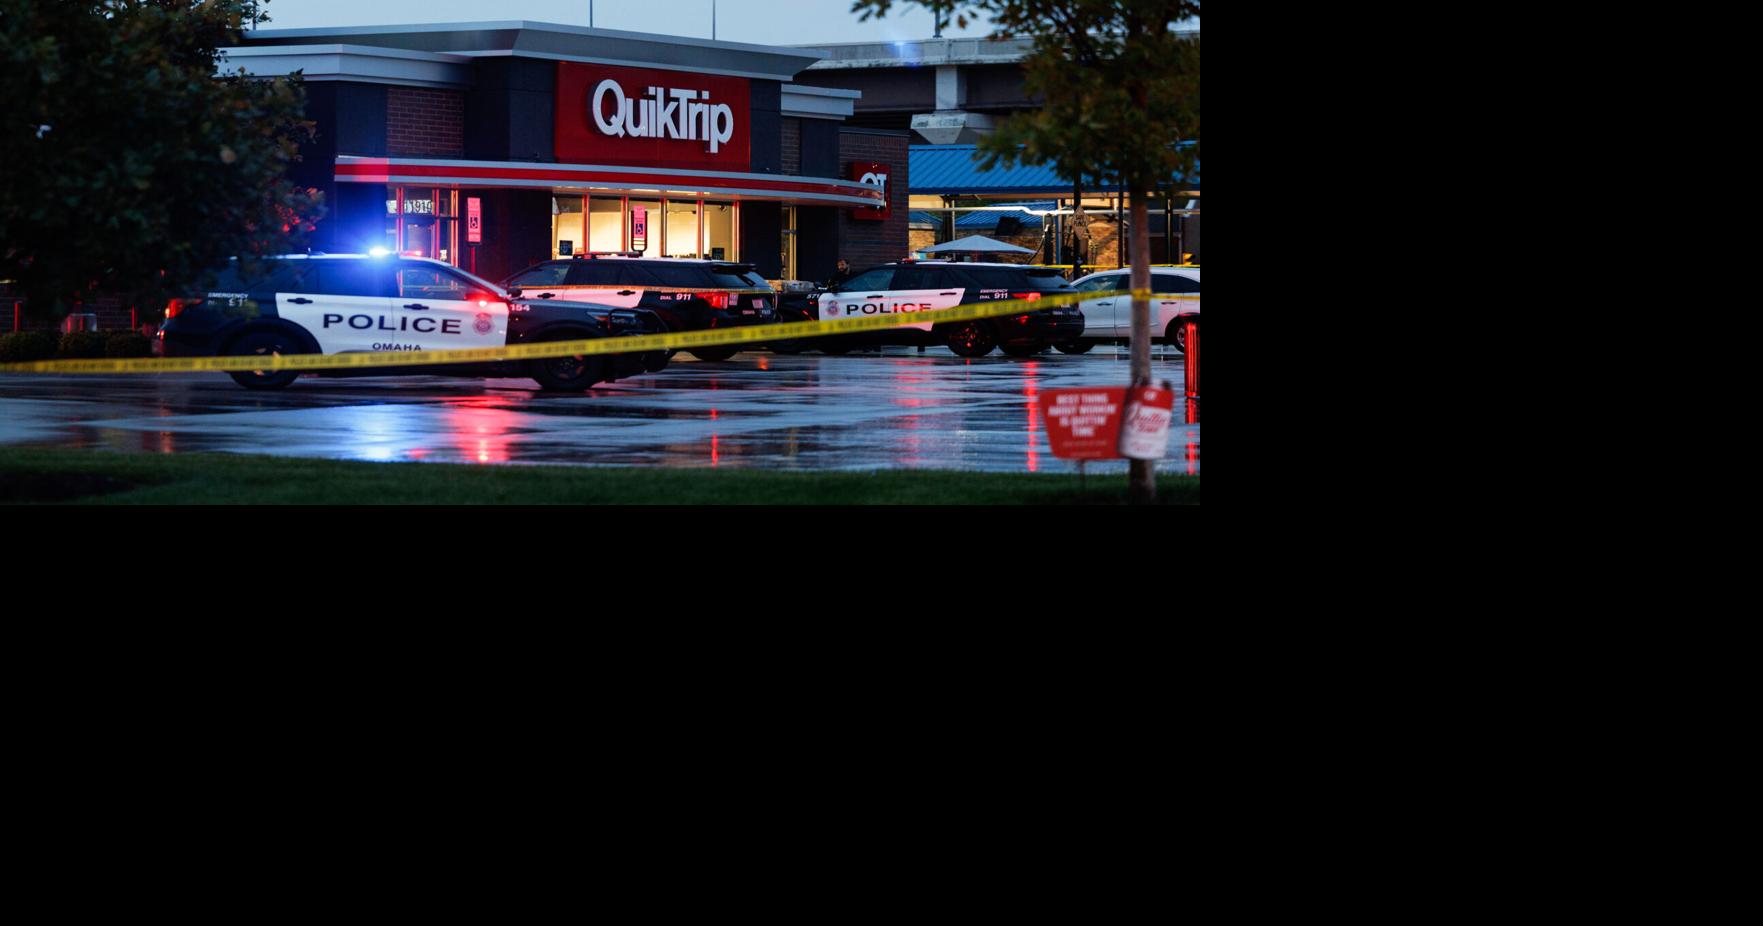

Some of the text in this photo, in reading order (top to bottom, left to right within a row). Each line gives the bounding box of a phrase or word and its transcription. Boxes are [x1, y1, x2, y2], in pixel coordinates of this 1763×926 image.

[592, 79, 733, 153] QuikTrip
[676, 293, 692, 301] 911
[509, 304, 531, 312] 154
[846, 302, 932, 315] POLICE
[322, 313, 462, 335] POLICE
[372, 342, 422, 352] OMAHA
